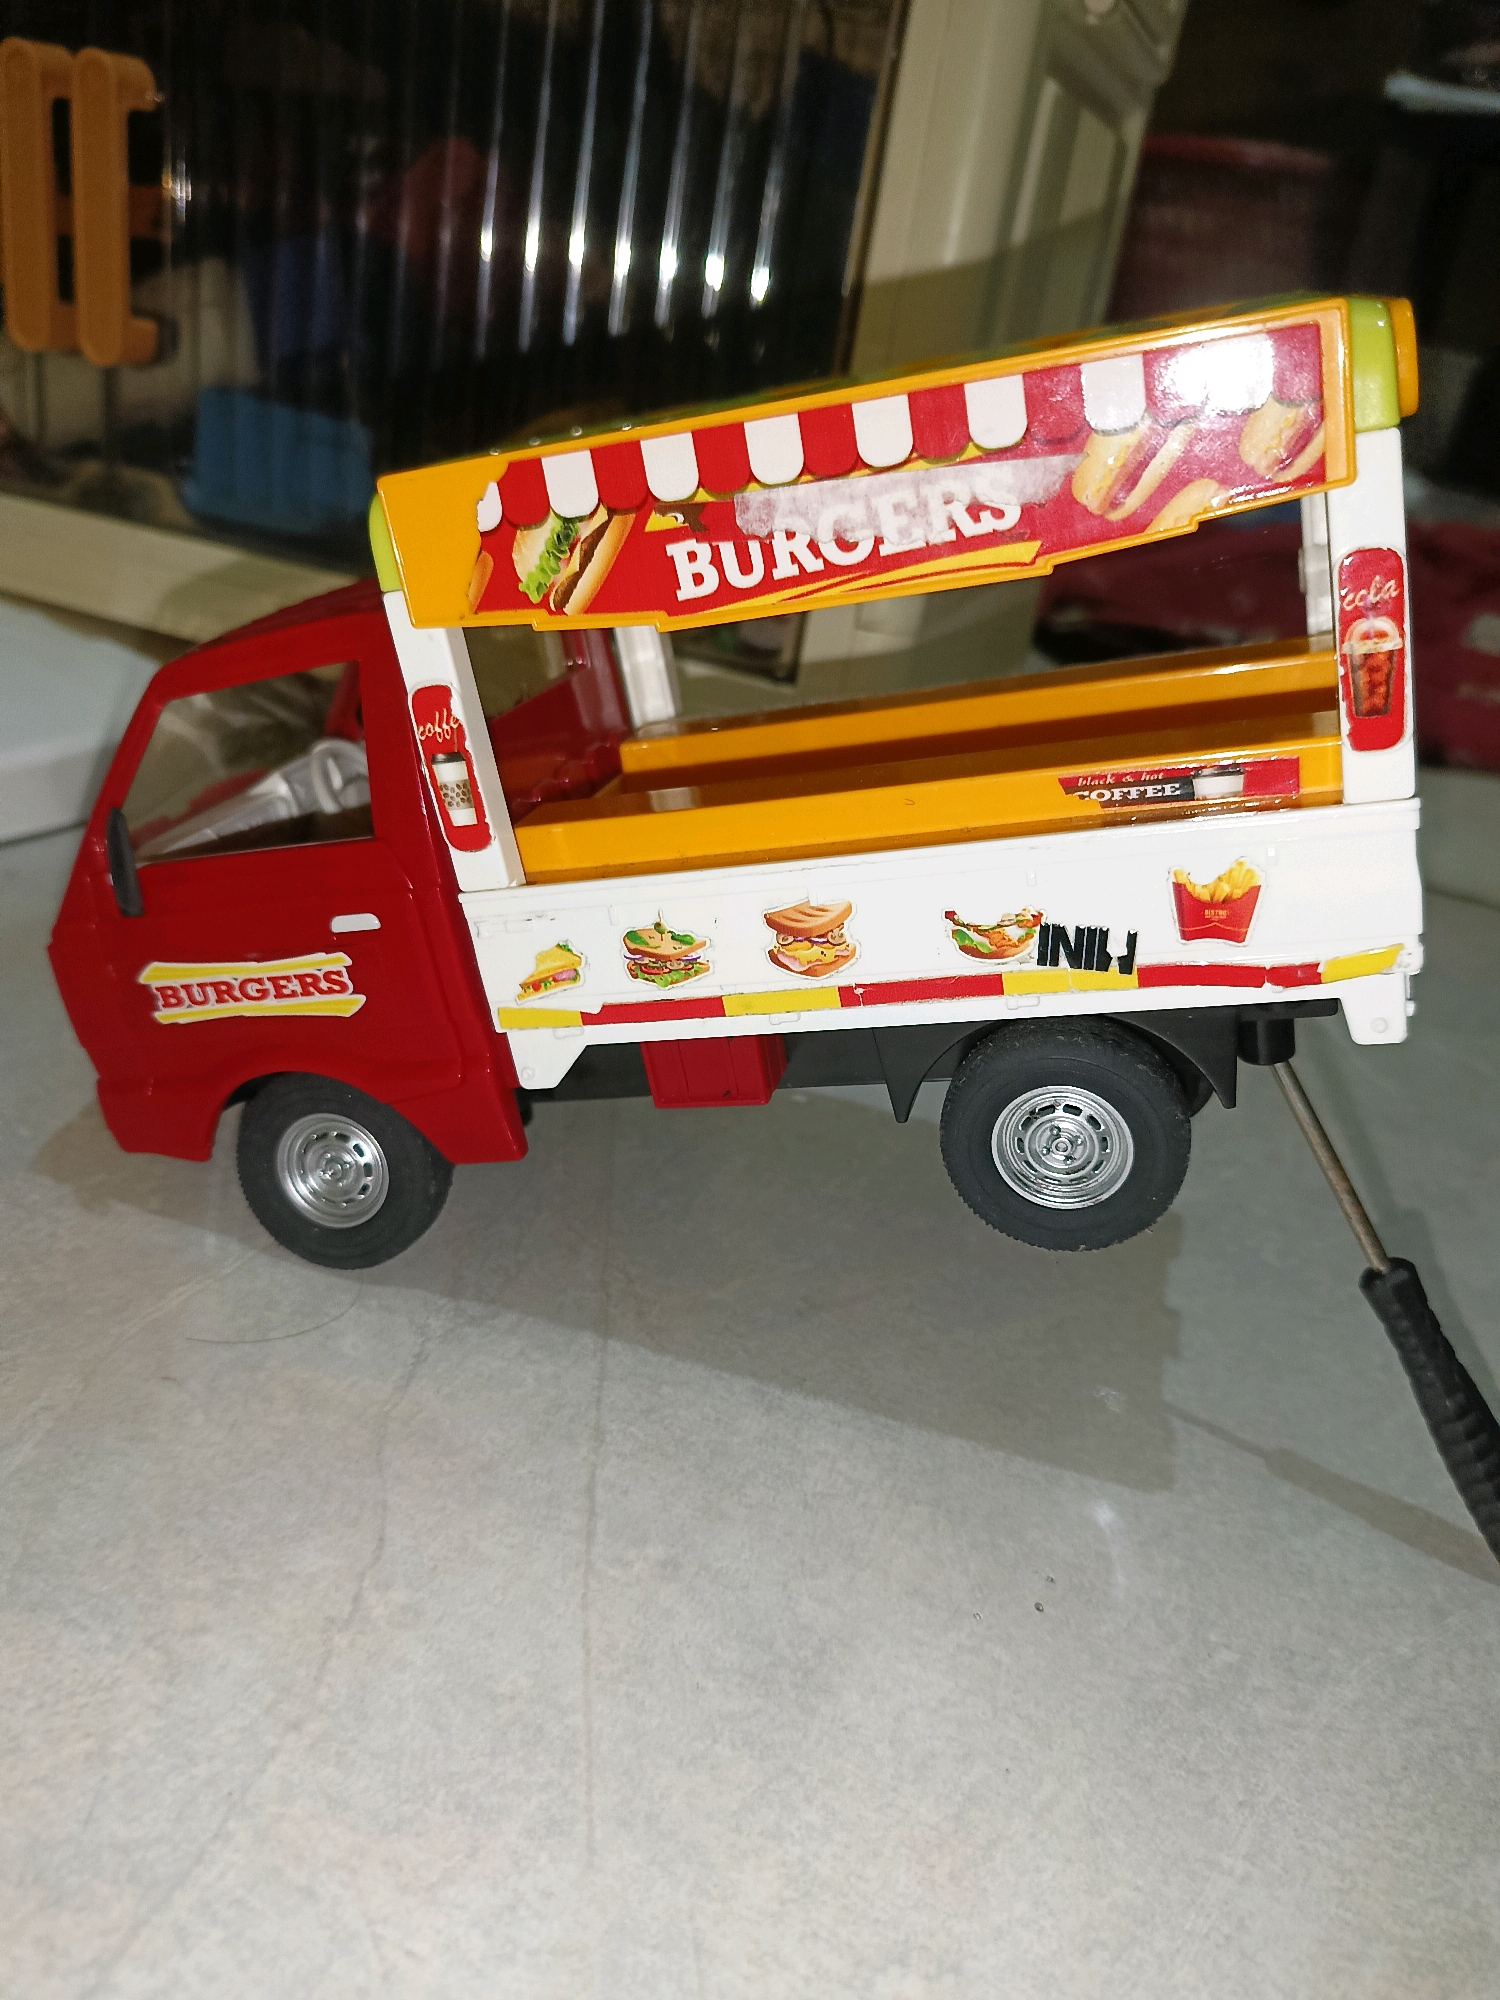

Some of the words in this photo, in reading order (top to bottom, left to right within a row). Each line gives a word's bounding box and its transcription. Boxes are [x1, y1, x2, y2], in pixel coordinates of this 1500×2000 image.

[665, 474, 1021, 601] BURGERS
[1077, 774, 1115, 787] black
[1121, 775, 1134, 783] &
[1140, 771, 1164, 781] hot
[155, 969, 350, 1009] BURGERS
